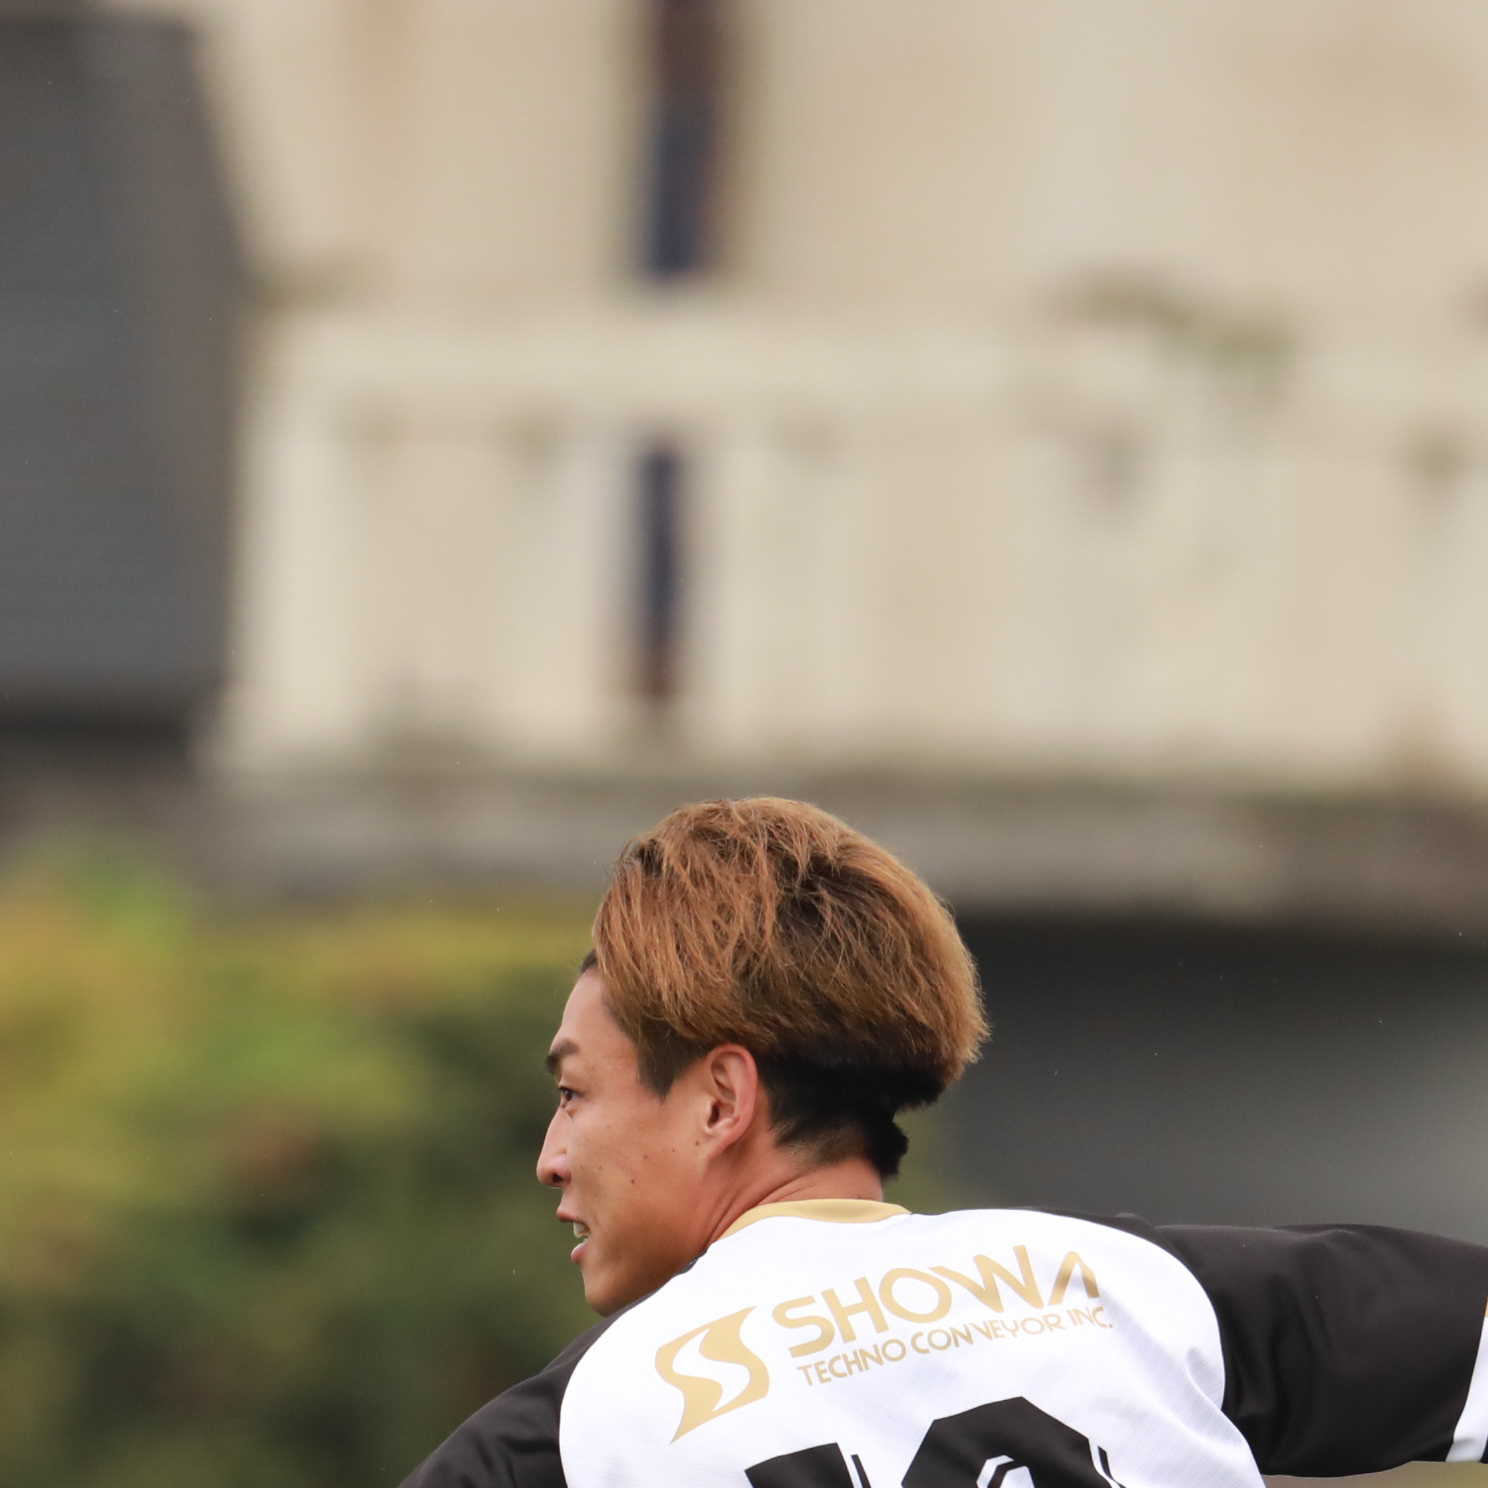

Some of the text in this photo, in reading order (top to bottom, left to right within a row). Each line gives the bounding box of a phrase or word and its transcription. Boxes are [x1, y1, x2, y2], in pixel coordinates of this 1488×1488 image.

[772, 1245, 1100, 1358] SHOWA
[796, 1305, 1114, 1386] TECHNO CONVEYOR INC.
